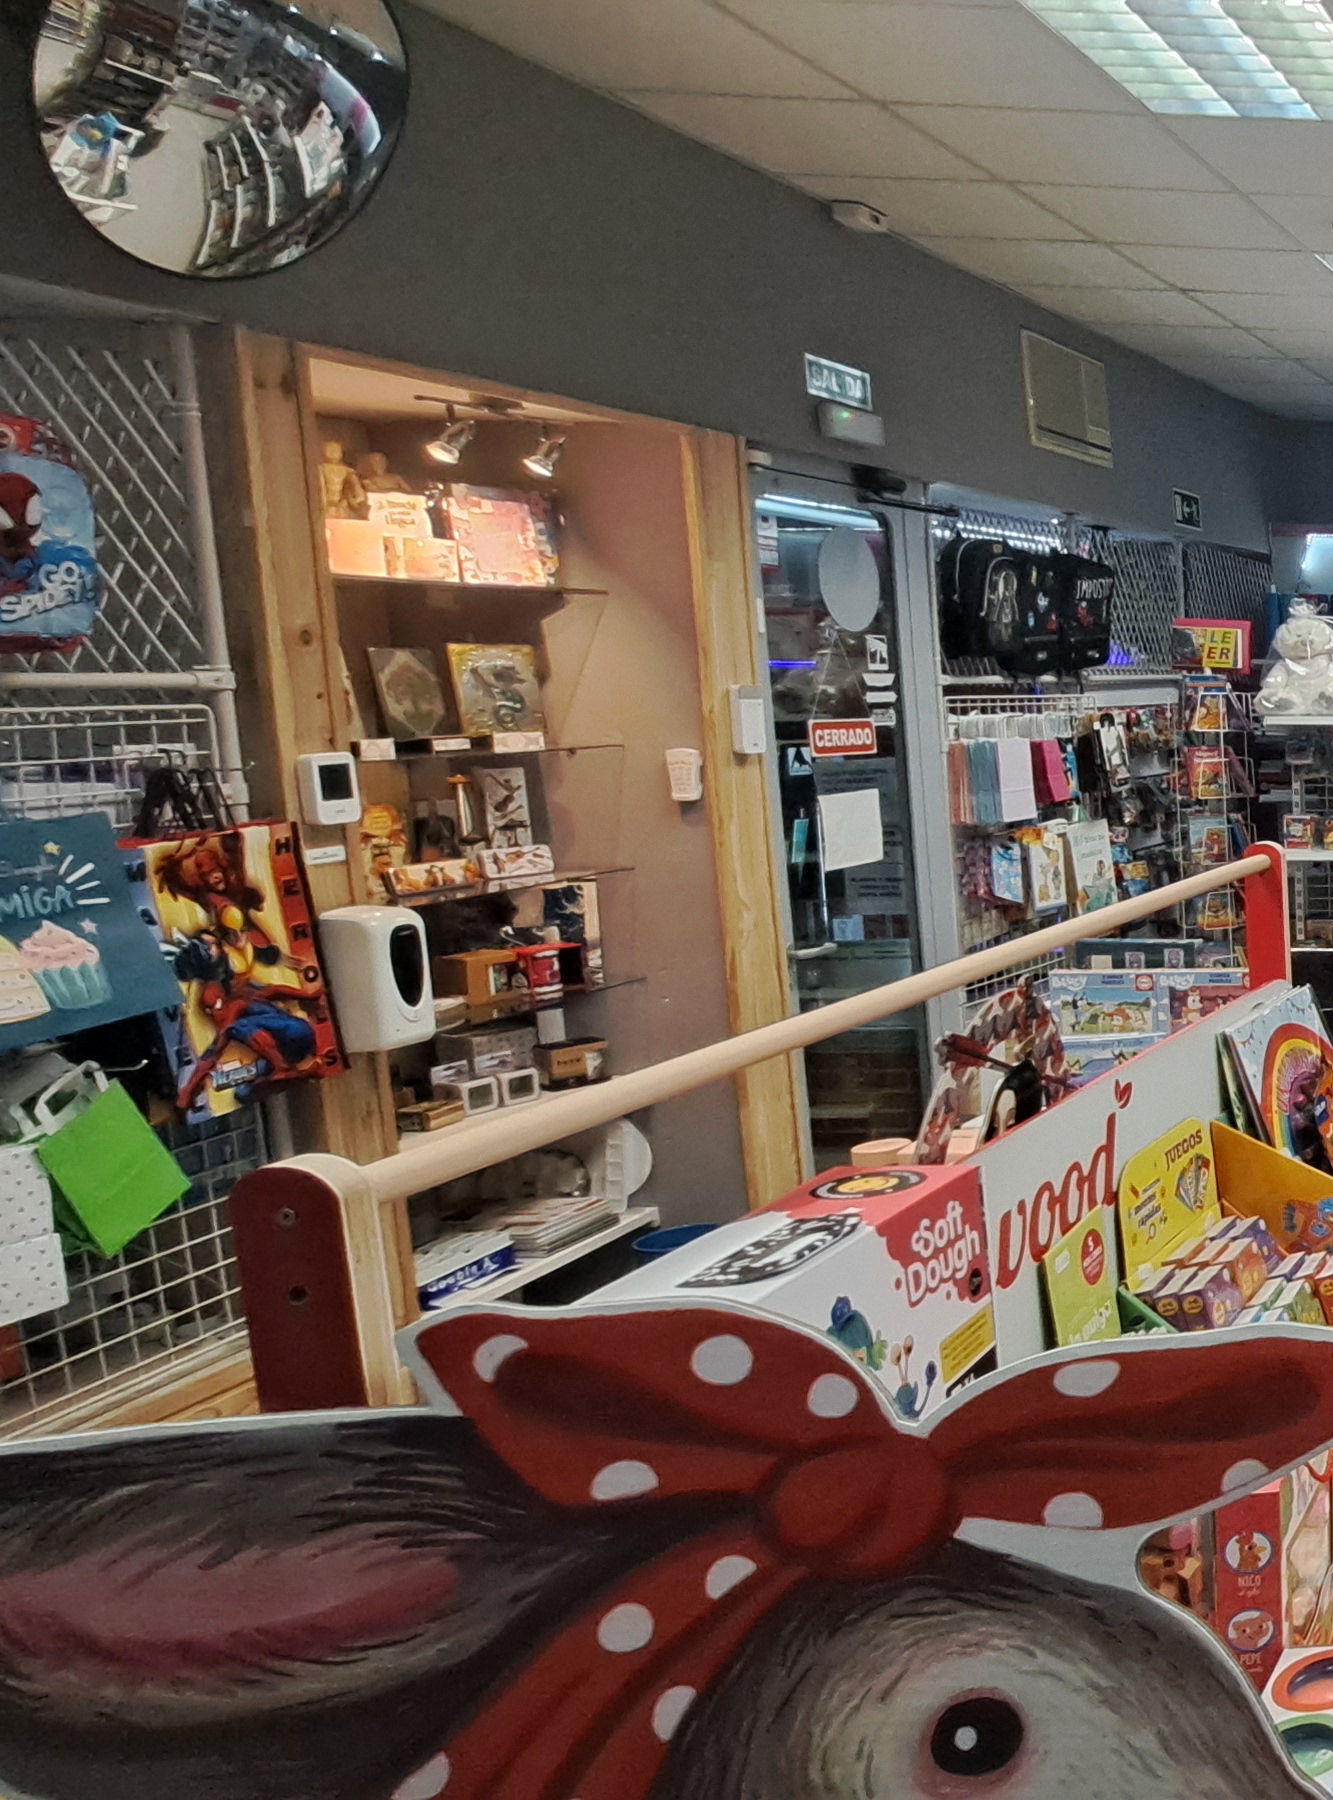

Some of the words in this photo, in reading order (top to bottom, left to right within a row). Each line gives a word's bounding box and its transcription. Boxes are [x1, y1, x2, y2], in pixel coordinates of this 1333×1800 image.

[811, 363, 863, 400] SALDA
[815, 728, 873, 749] CERRADO
[1165, 1129, 1203, 1172] JUEGOS
[913, 1199, 964, 1259] Soft
[905, 1223, 982, 1308] Dough
[1240, 1653, 1262, 1665] PEPE
